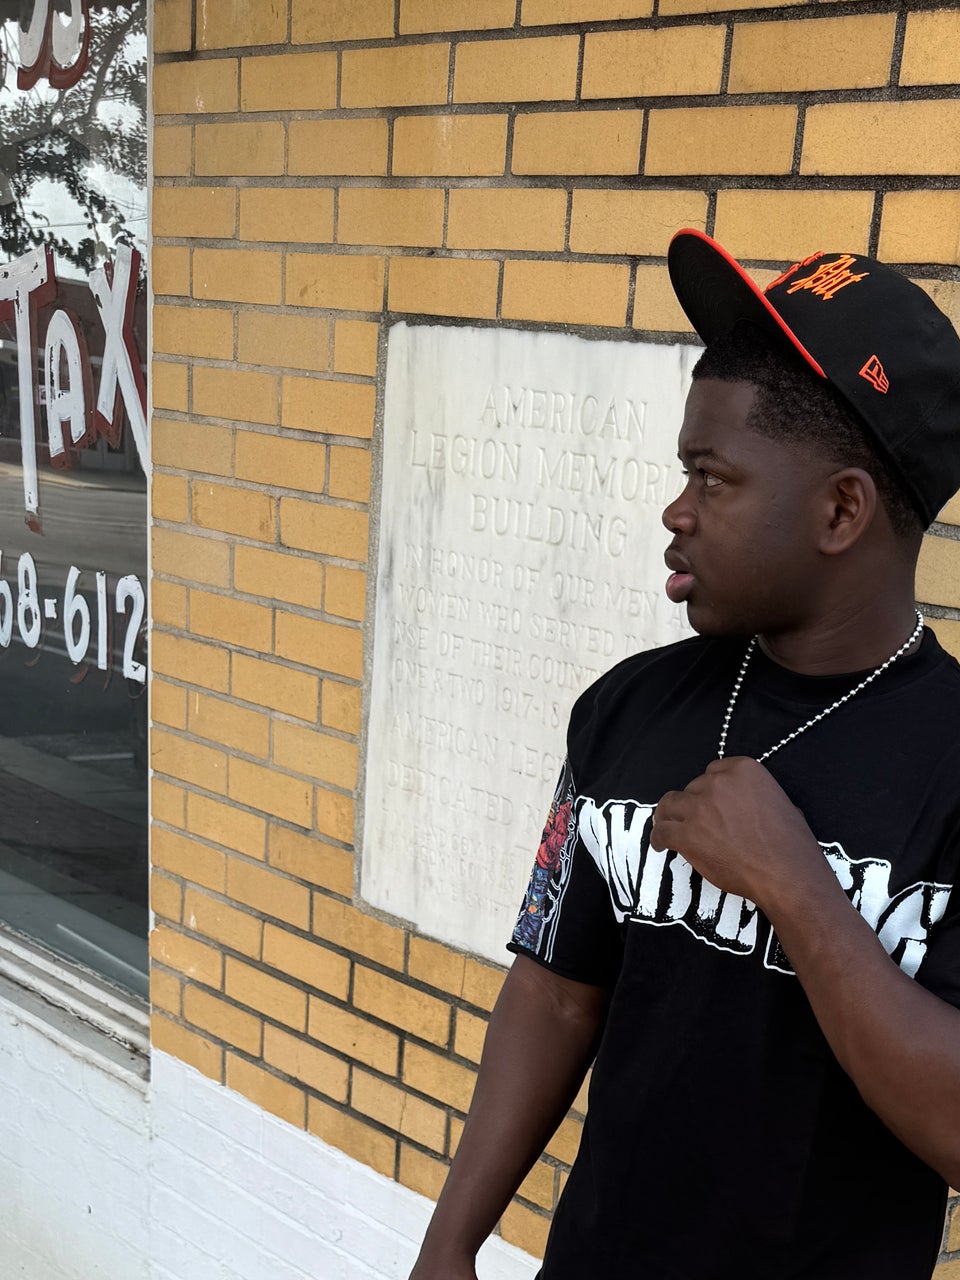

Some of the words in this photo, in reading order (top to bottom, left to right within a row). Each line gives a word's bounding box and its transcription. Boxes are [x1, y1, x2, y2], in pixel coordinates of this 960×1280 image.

[0, 243, 149, 515] TAX
[479, 384, 649, 443] AMERICAN
[406, 430, 522, 484] LEGION
[469, 493, 630, 558] BUILDING
[402, 543, 423, 568] IN
[430, 547, 503, 584] HONOR
[512, 562, 542, 594] OF
[551, 571, 596, 609] OUR
[602, 582, 660, 619] MEN
[398, 582, 471, 622] WOMEN
[478, 599, 522, 634] WHO
[528, 612, 616, 657] SERVED
[392, 657, 430, 689] ONE
[448, 672, 486, 706] TWO
[437, 629, 465, 659] OF
[470, 638, 523, 678] THEIR
[529, 653, 606, 691] COUNT
[390, 710, 500, 768] AMERICAN
[386, 758, 515, 827] DEDICATED
